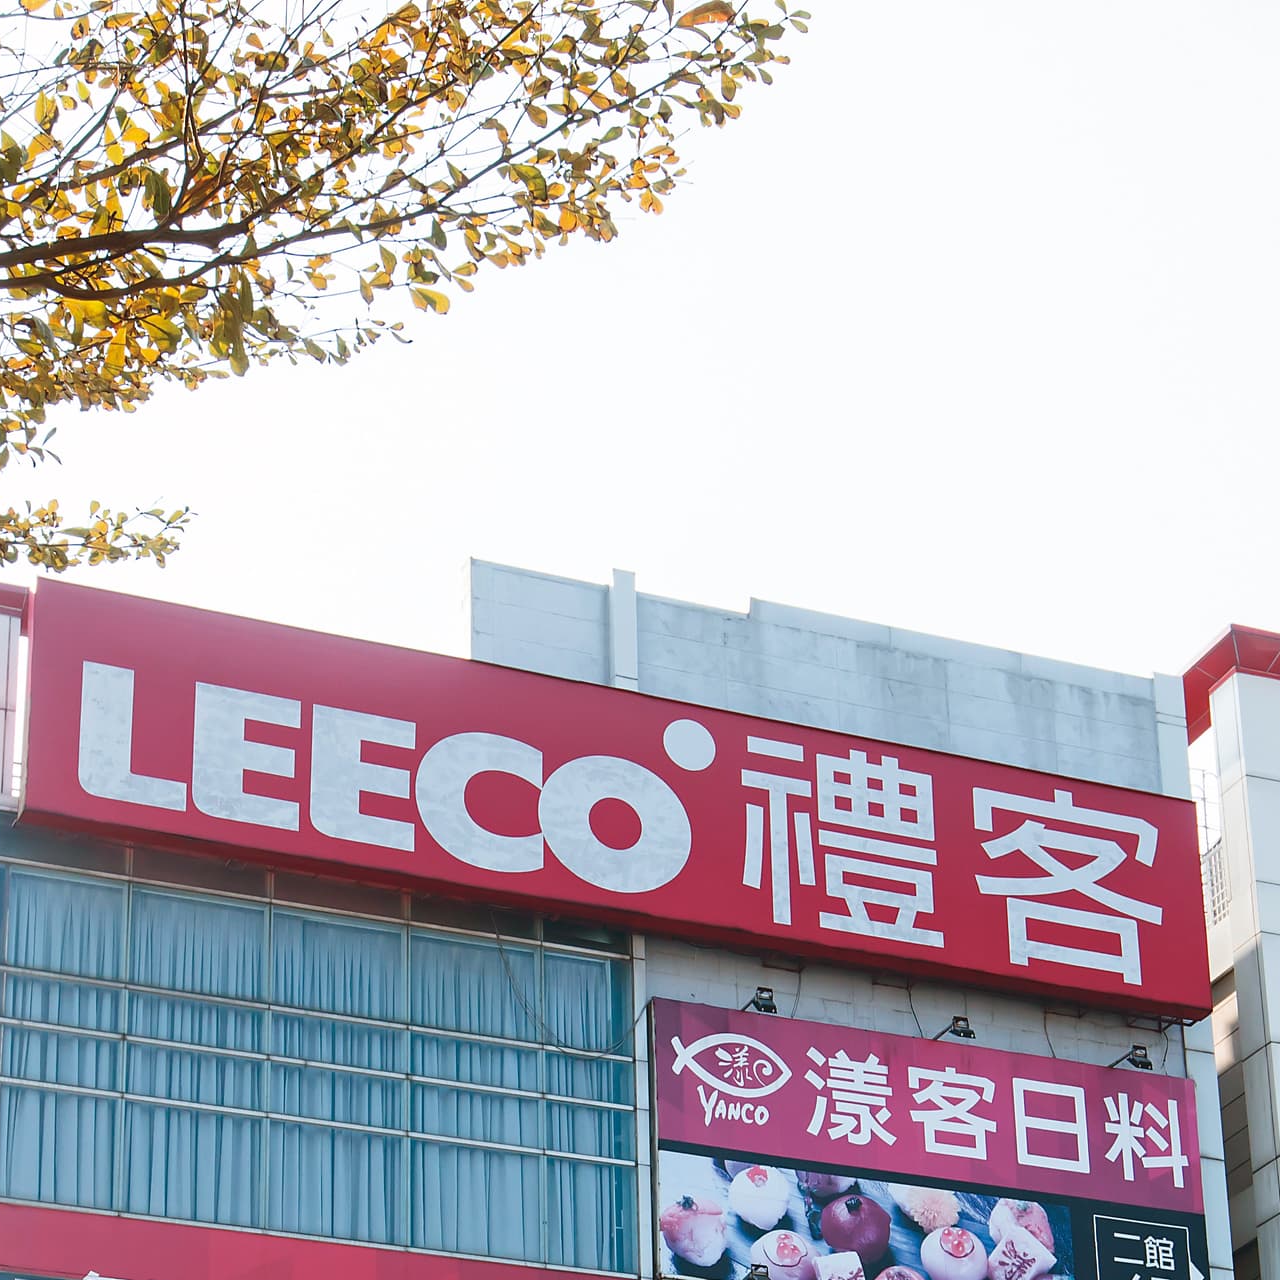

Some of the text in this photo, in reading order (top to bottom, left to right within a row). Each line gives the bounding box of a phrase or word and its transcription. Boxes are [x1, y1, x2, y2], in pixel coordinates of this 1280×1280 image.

[77, 660, 1163, 987] LEECO 禮客
[696, 1084, 770, 1128] YANCO
[803, 1045, 1189, 1189] 漾客日料
[1112, 1231, 1176, 1272] 二館
